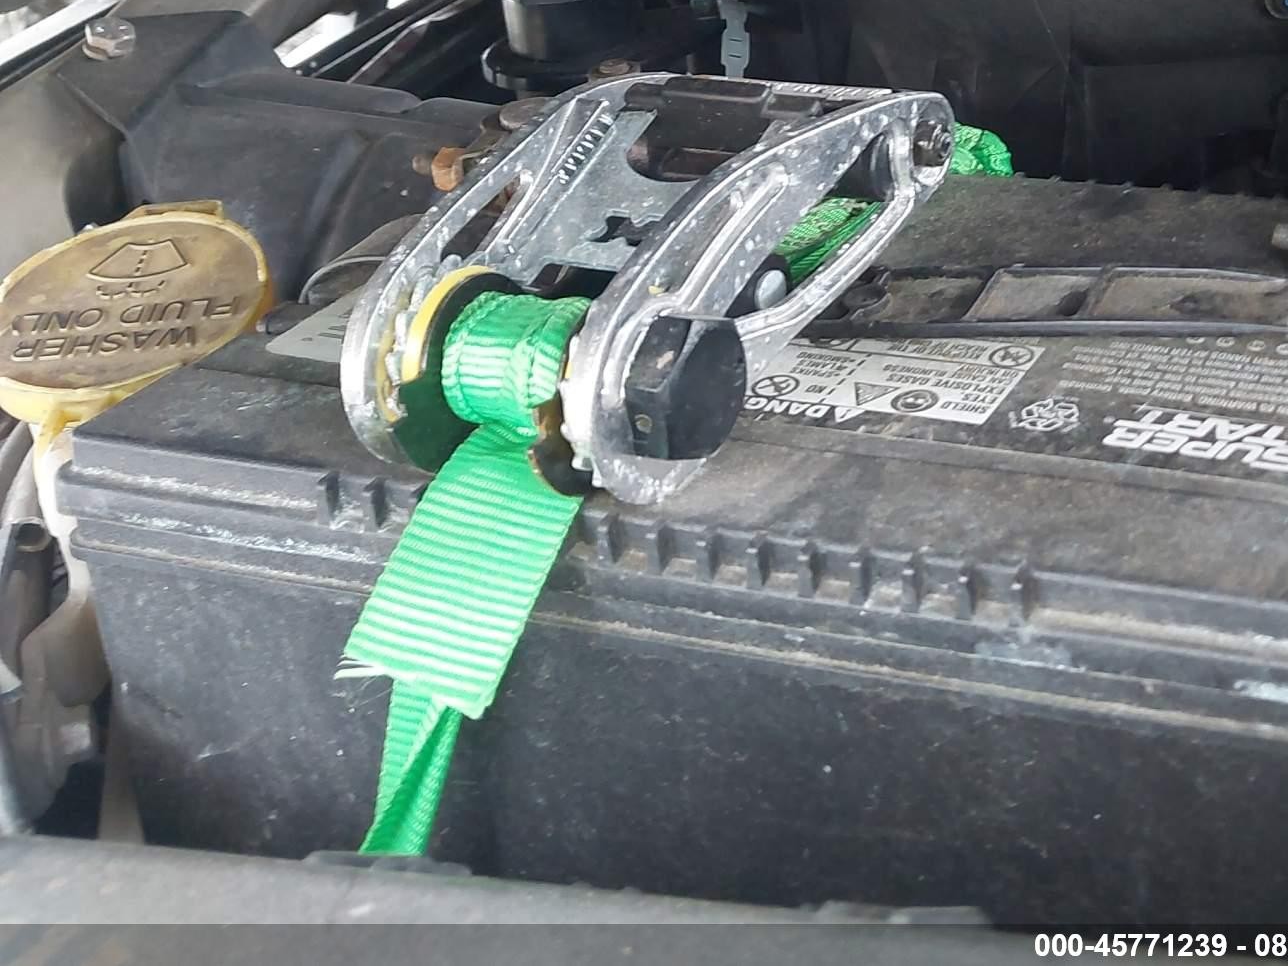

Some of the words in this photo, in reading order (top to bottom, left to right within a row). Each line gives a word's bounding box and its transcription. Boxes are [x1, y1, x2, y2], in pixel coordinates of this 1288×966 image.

[120, 296, 241, 327] FLUID
[11, 326, 196, 362] WASHER
[886, 372, 929, 385] GASES
[934, 378, 1008, 395] EXPLOSIVE
[805, 385, 827, 394] NO
[744, 396, 831, 418] DANG
[940, 400, 990, 415] SHIELD
